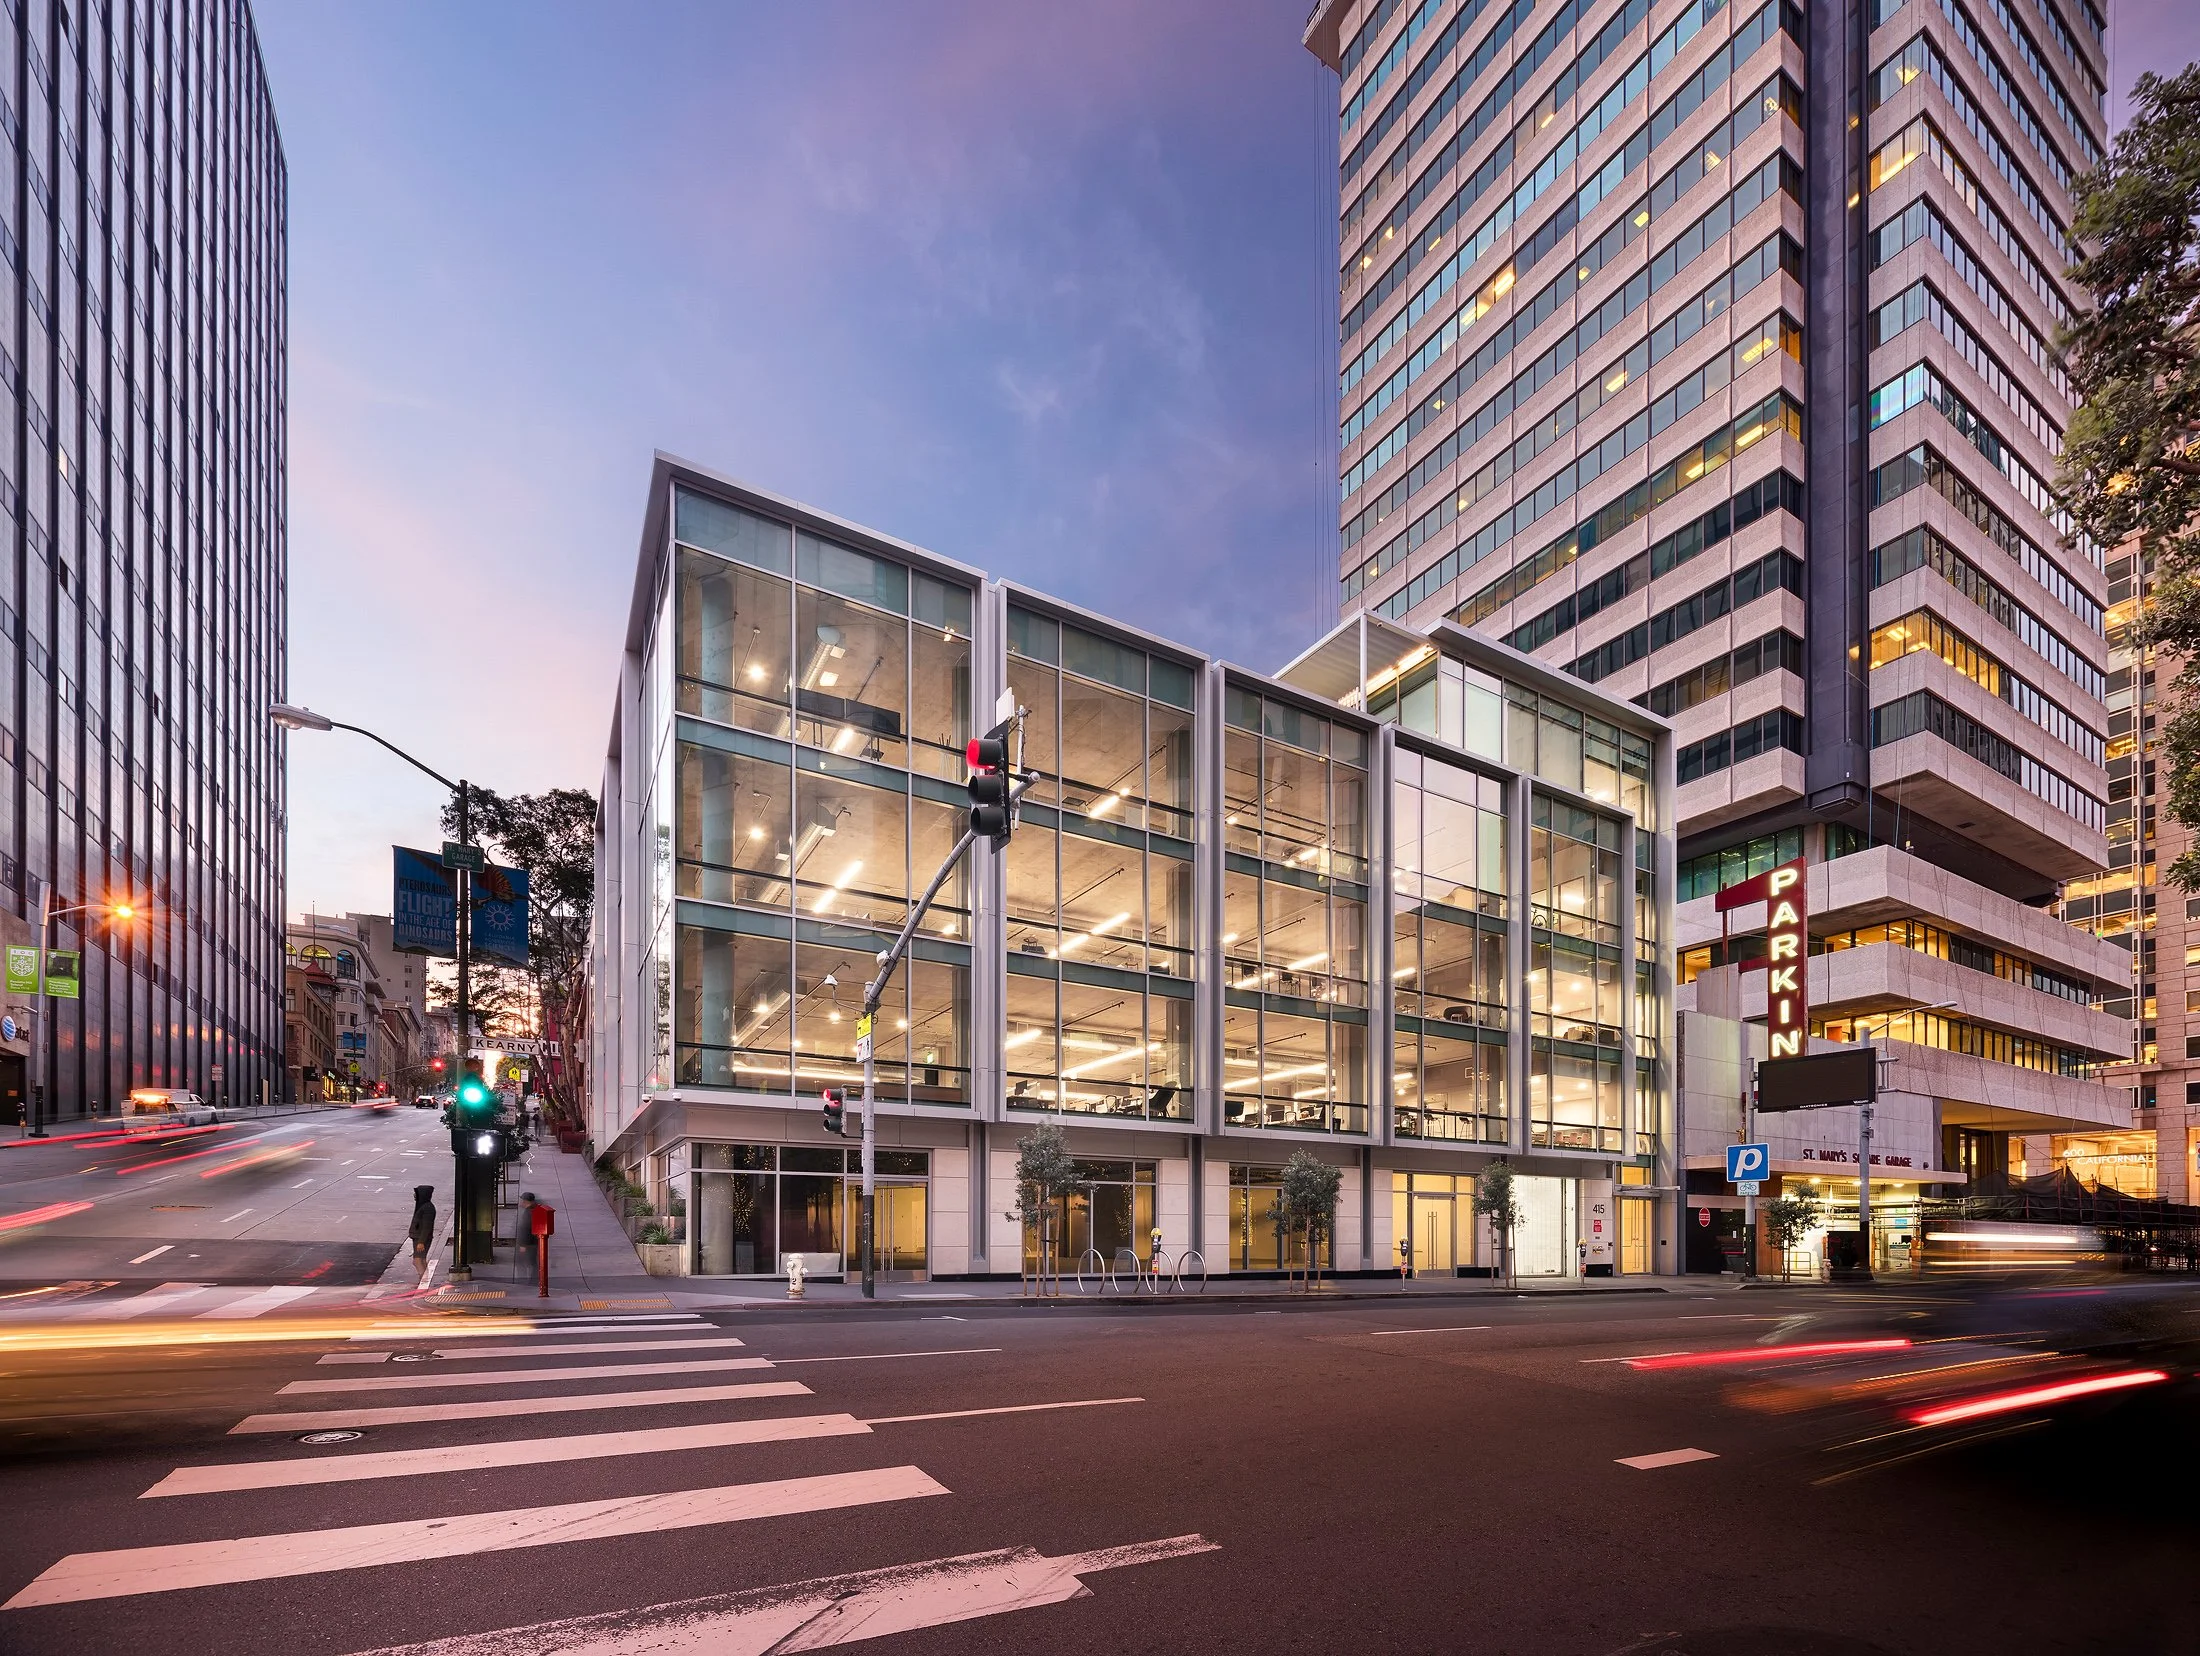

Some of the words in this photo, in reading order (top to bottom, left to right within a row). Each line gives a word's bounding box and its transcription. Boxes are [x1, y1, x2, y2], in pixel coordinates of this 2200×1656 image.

[452, 852, 475, 863] GARAGE
[458, 845, 482, 856] MARY'S
[399, 879, 453, 896] PTEROSAURS
[399, 891, 453, 919] FLIGHT
[399, 911, 407, 922] IN
[408, 913, 424, 924] THE
[426, 916, 440, 928] AGE
[442, 918, 453, 930] OF
[399, 925, 453, 943] DINOSAURS
[1770, 868, 1800, 1058] PARKIN
[476, 1039, 536, 1052] KEARNY
[1803, 1148, 1816, 1160] ST.
[1819, 1150, 1847, 1162] MARY'S
[1886, 1156, 1912, 1167] GARAGE
[2063, 1148, 2084, 1157] 600
[2077, 1154, 2146, 1164] CALIFORNIA
[1593, 1204, 1605, 1214] 415
